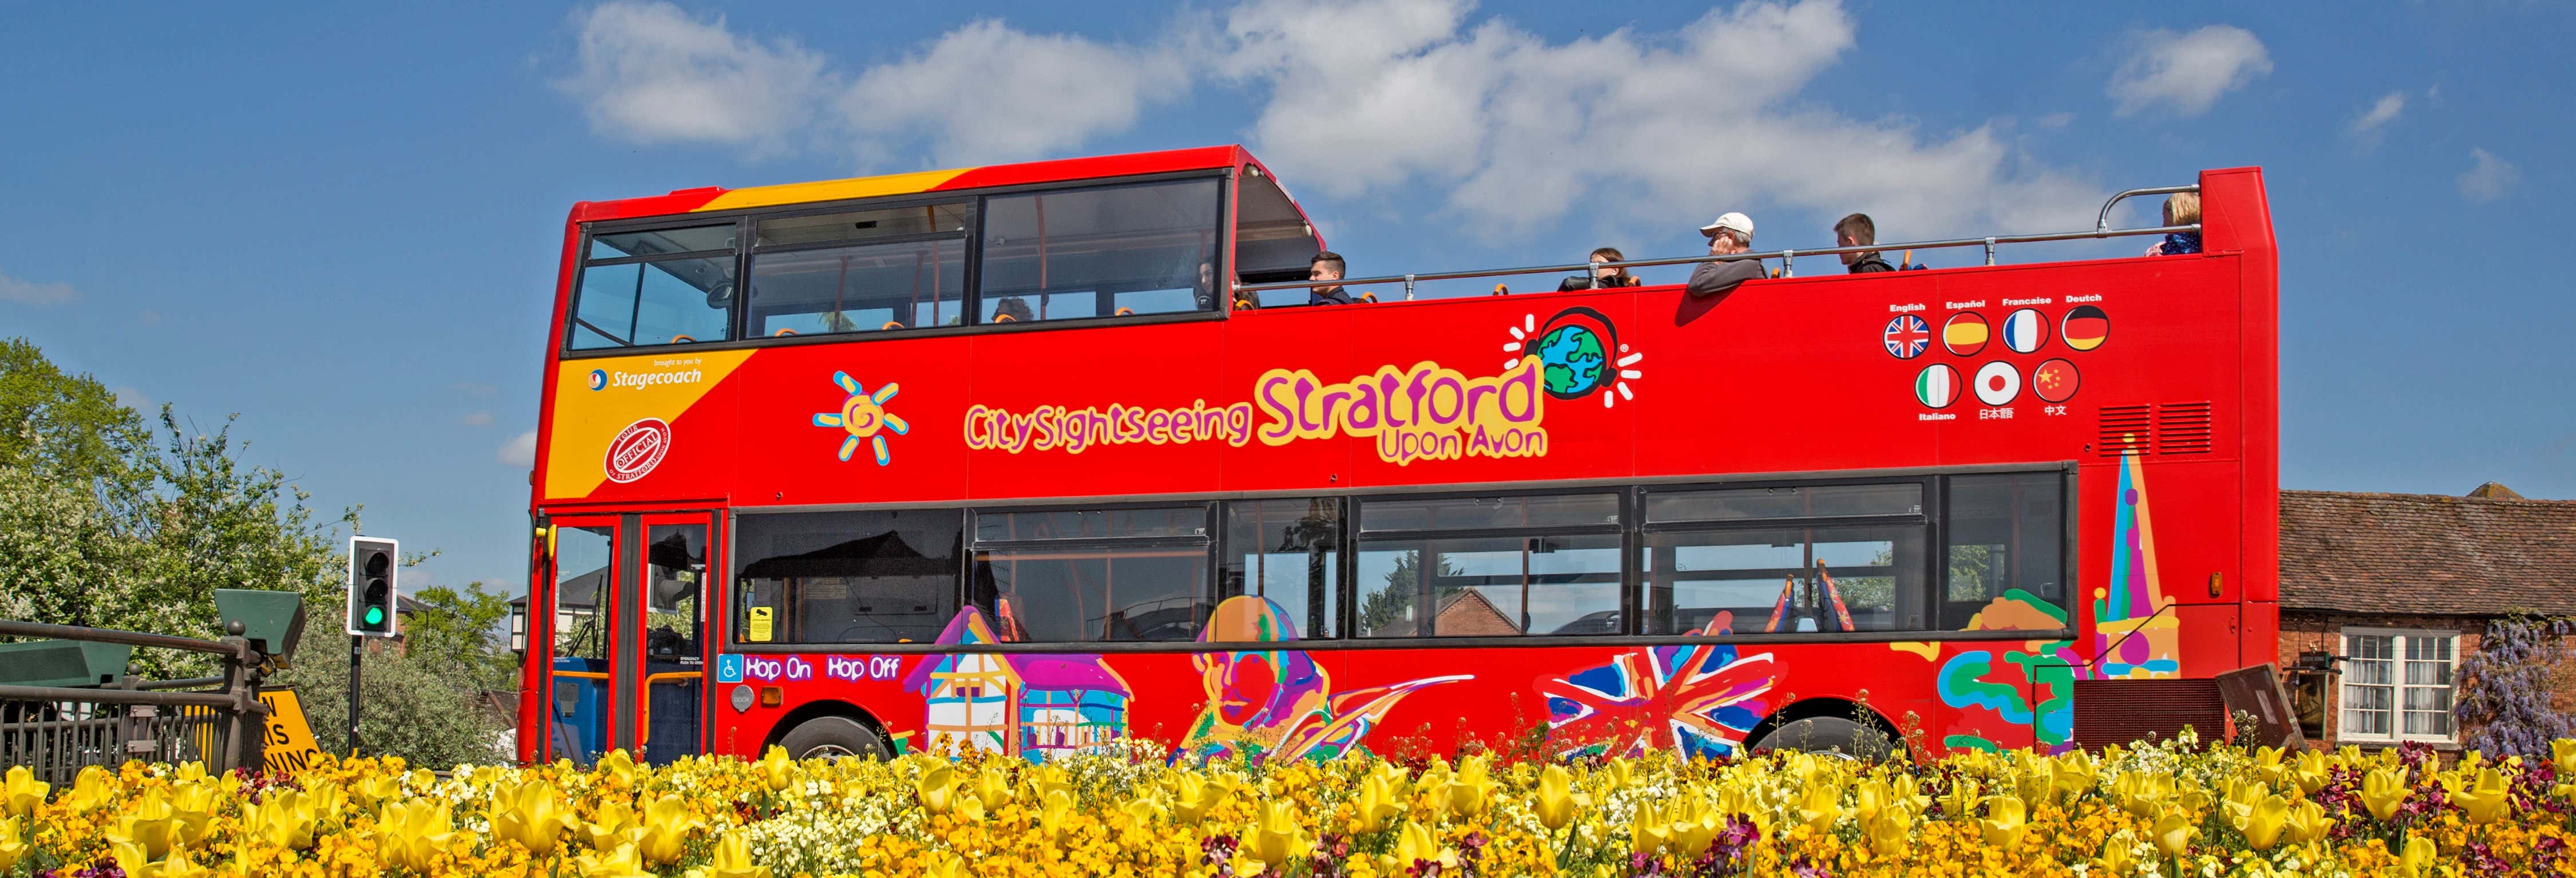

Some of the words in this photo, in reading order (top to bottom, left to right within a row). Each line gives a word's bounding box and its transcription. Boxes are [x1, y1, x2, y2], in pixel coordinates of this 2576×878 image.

[2002, 296, 2052, 306] Francaise
[2065, 294, 2102, 303] Deutch
[1890, 303, 1926, 313] English
[1946, 300, 1985, 310] Español
[654, 359, 675, 367] brought
[695, 357, 702, 366] by
[612, 369, 702, 390] Stagecoach
[966, 401, 1251, 452] CitySightseeing
[1261, 362, 1538, 439] Stratford
[2044, 405, 2067, 416] 中文
[1919, 413, 1956, 421] Italiano
[1979, 408, 2014, 420] 日本語
[617, 425, 638, 442] TOUR
[616, 433, 658, 468] OFFICIAL
[1381, 428, 1459, 461] Upon
[617, 458, 657, 480] STRATFORD
[745, 657, 781, 681] Hop
[787, 656, 811, 679] On
[828, 657, 865, 681] Hop
[870, 656, 900, 679] Off
